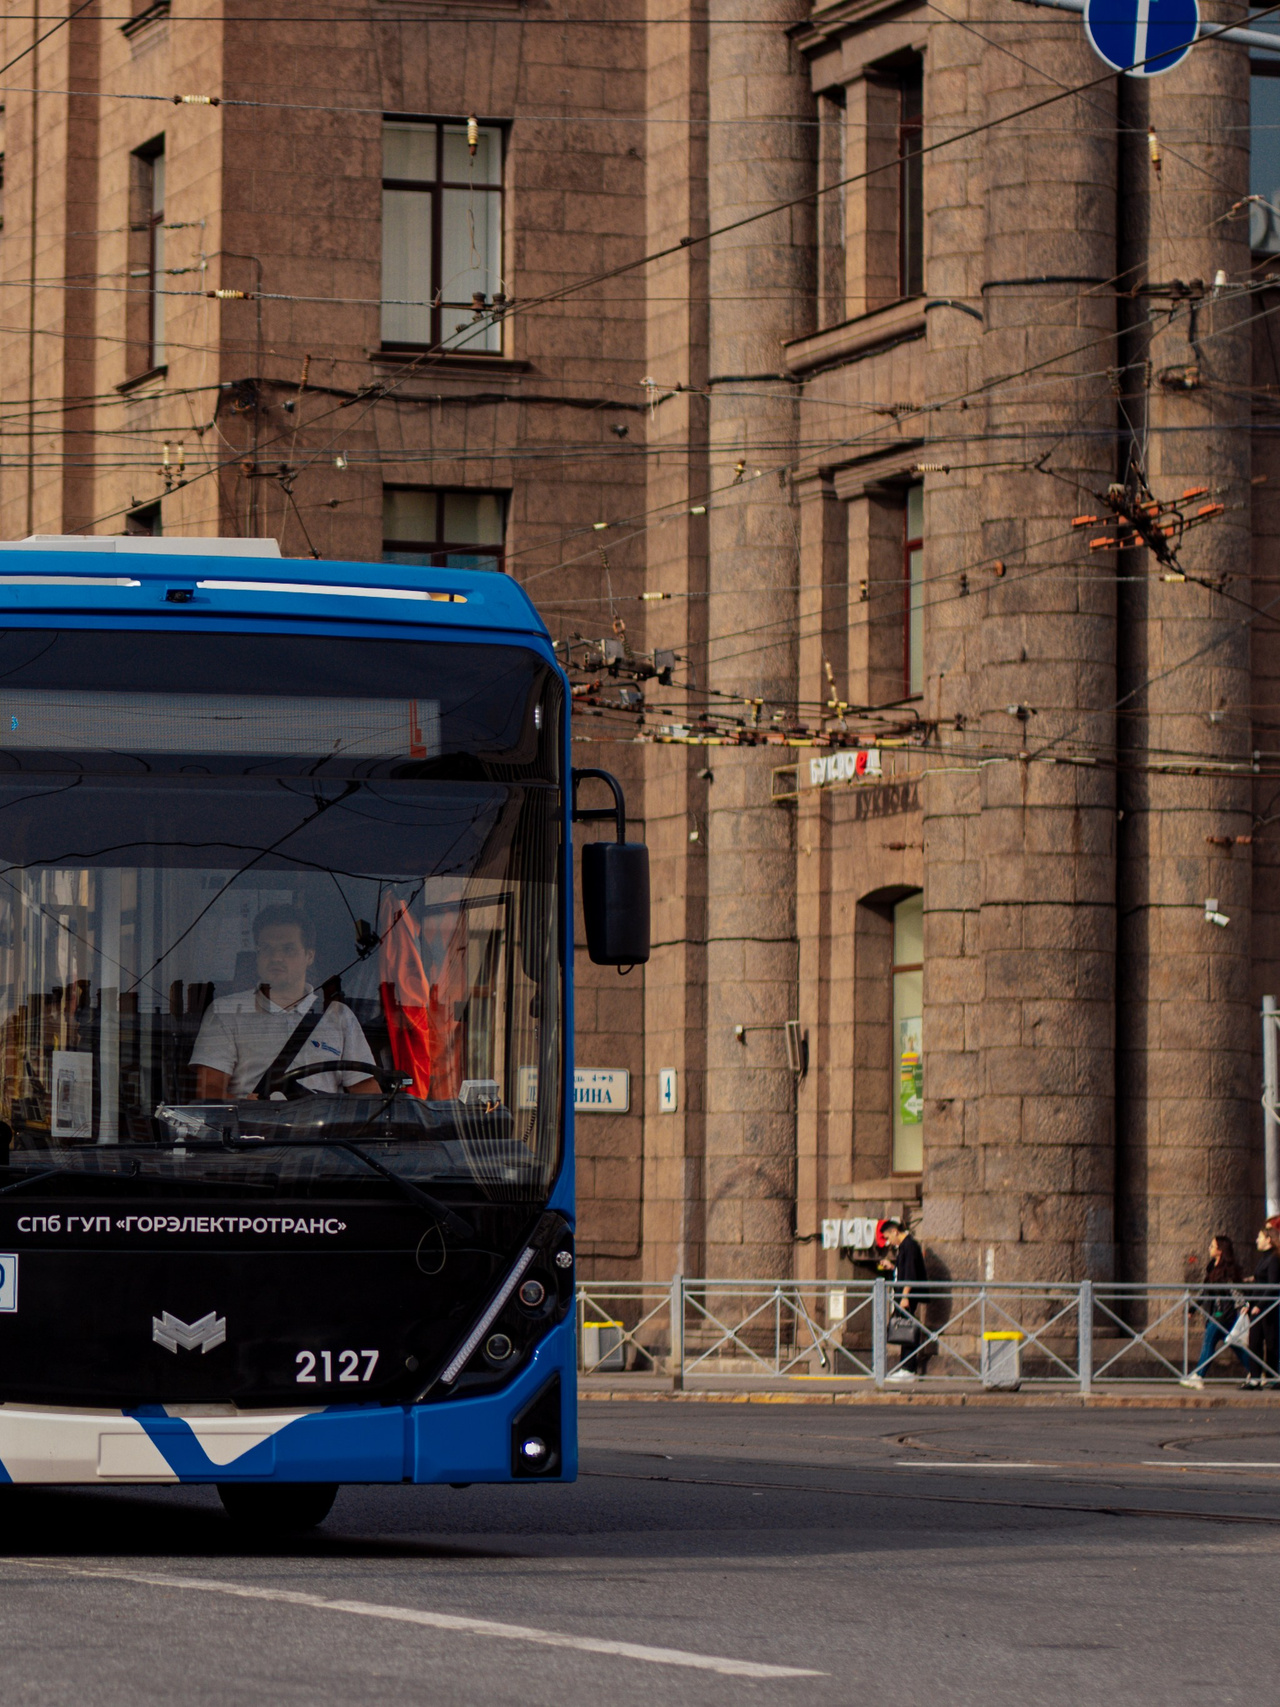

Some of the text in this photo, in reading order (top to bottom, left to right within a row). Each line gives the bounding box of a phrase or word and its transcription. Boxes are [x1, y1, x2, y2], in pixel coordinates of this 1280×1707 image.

[664, 1075, 671, 1103] 4
[17, 1214, 347, 1234] СПб ГУП «ГОРЭЛЕКТРОТРАНС»
[295, 1350, 380, 1382] 2127
